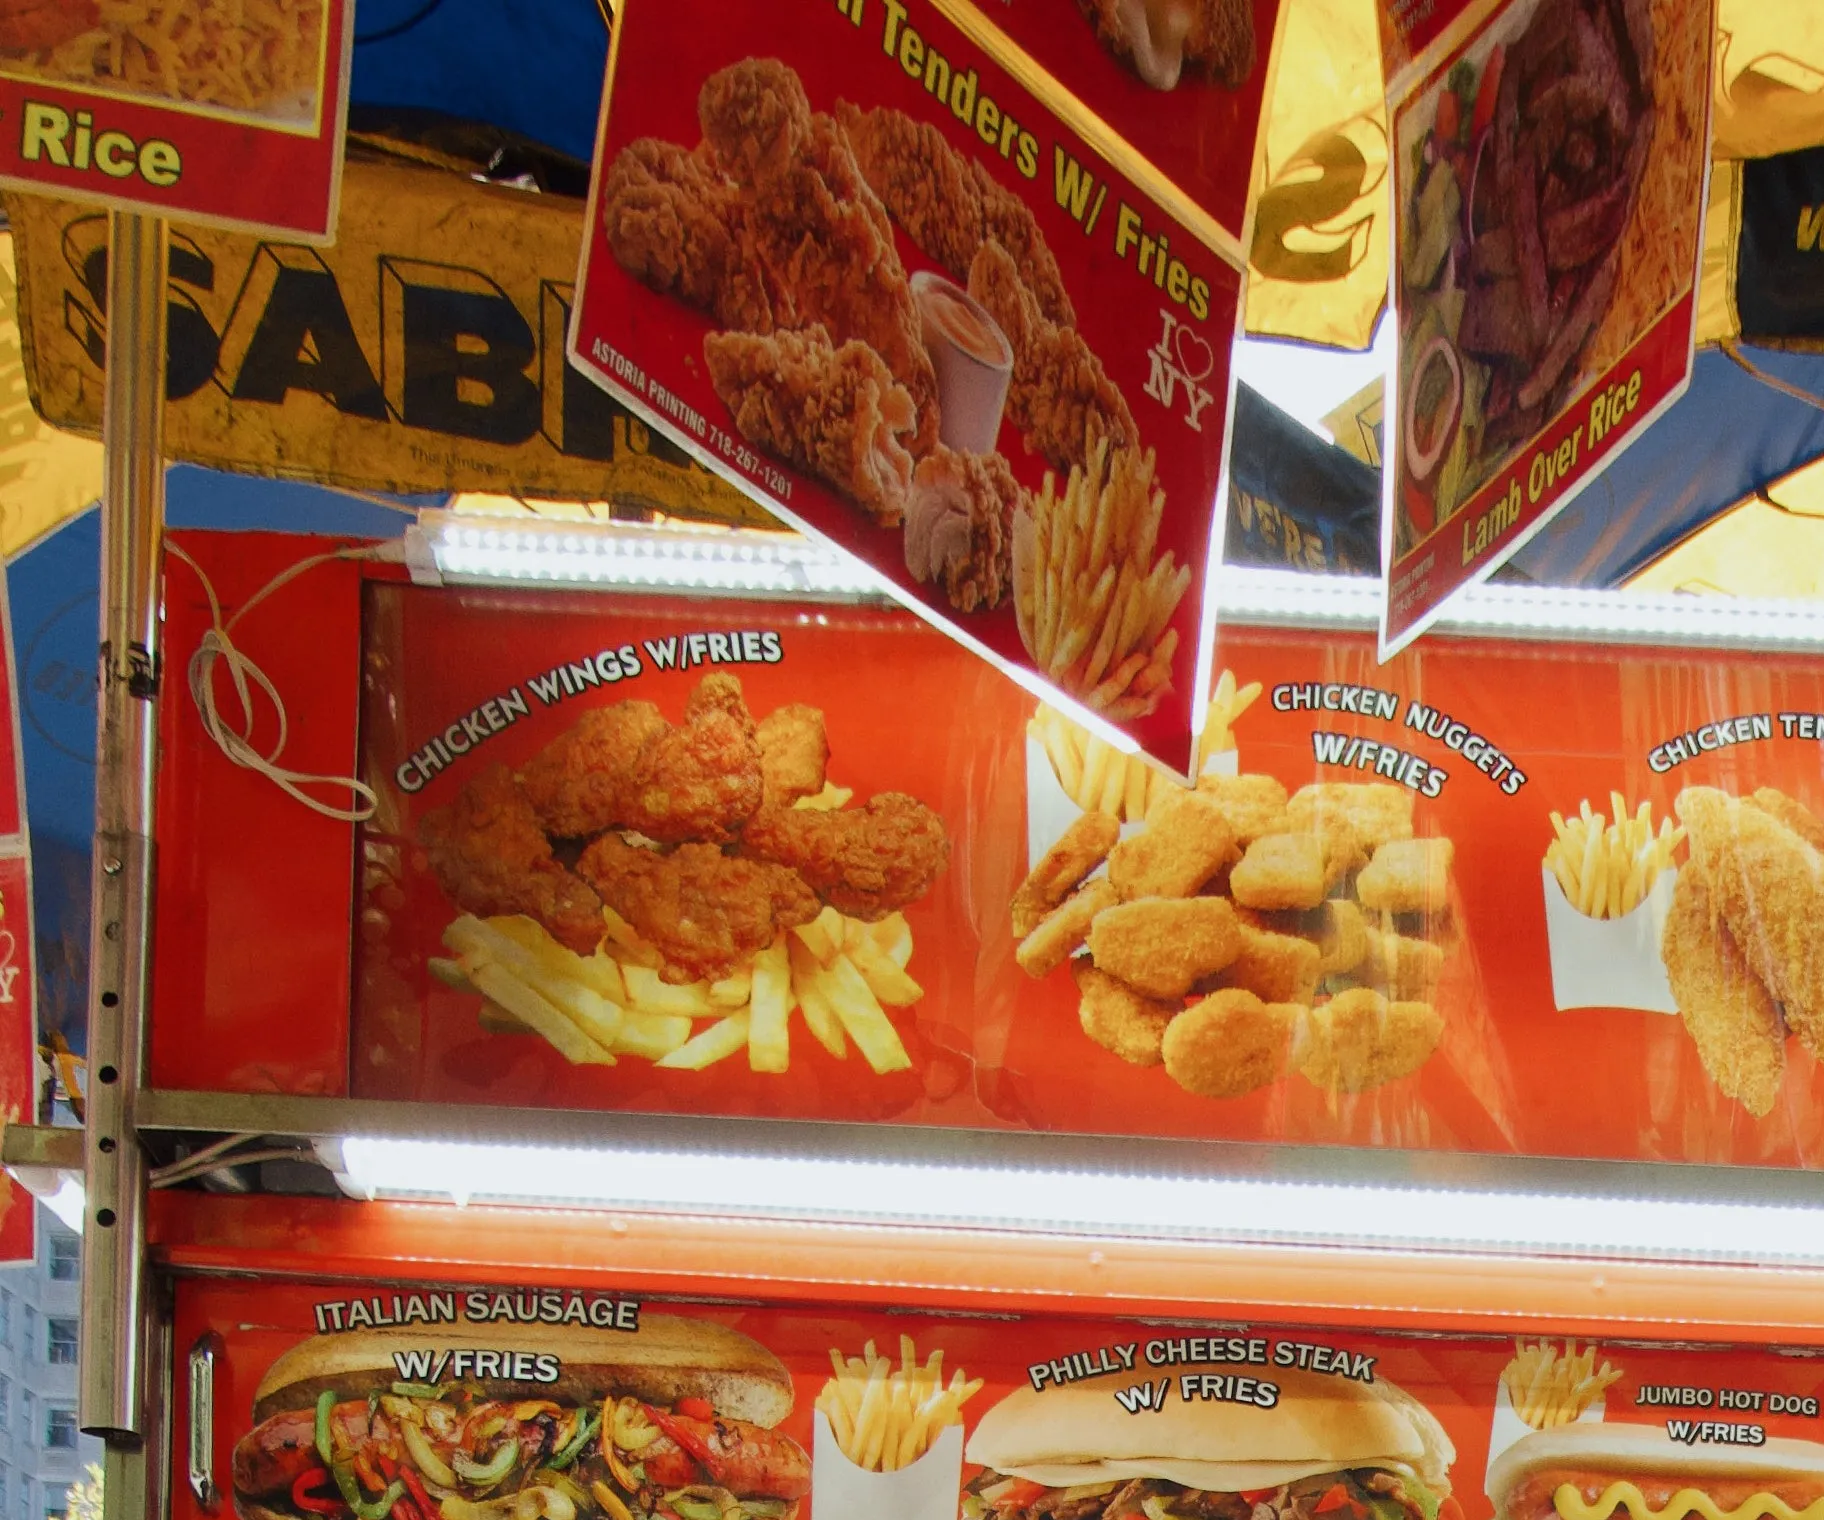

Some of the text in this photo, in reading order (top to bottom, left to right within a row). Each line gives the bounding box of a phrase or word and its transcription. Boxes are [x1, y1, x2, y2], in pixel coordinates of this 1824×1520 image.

[21, 100, 183, 188] Rice
[882, 0, 1039, 180] Tenders
[1052, 143, 1107, 236] W/
[1114, 201, 1210, 321] Fries
[1159, 308, 1177, 361] I
[591, 336, 646, 392] ASTORIA
[648, 379, 706, 438] PRINTING
[708, 423, 792, 501] 718-267-1201
[1142, 348, 1214, 433] NY
[1461, 368, 1643, 568] Lamb Over Rice
[395, 631, 784, 795] CHICKEN WINGS W/FRIES
[1271, 682, 1528, 796] CHICKEN NUGGETS
[1646, 712, 1774, 776] CHICKEN
[1311, 731, 1449, 802] W/FRIES
[314, 1289, 641, 1334] ITALIAN SAUSAGE
[392, 1349, 562, 1385] W/FRIES
[1028, 1336, 1377, 1390] PHILLY CHEESE STEAK
[1114, 1371, 1280, 1415] W/ FRIES
[1635, 1384, 1820, 1417] JUMBO HOT DOG
[1665, 1419, 1765, 1446] W/FRIES
